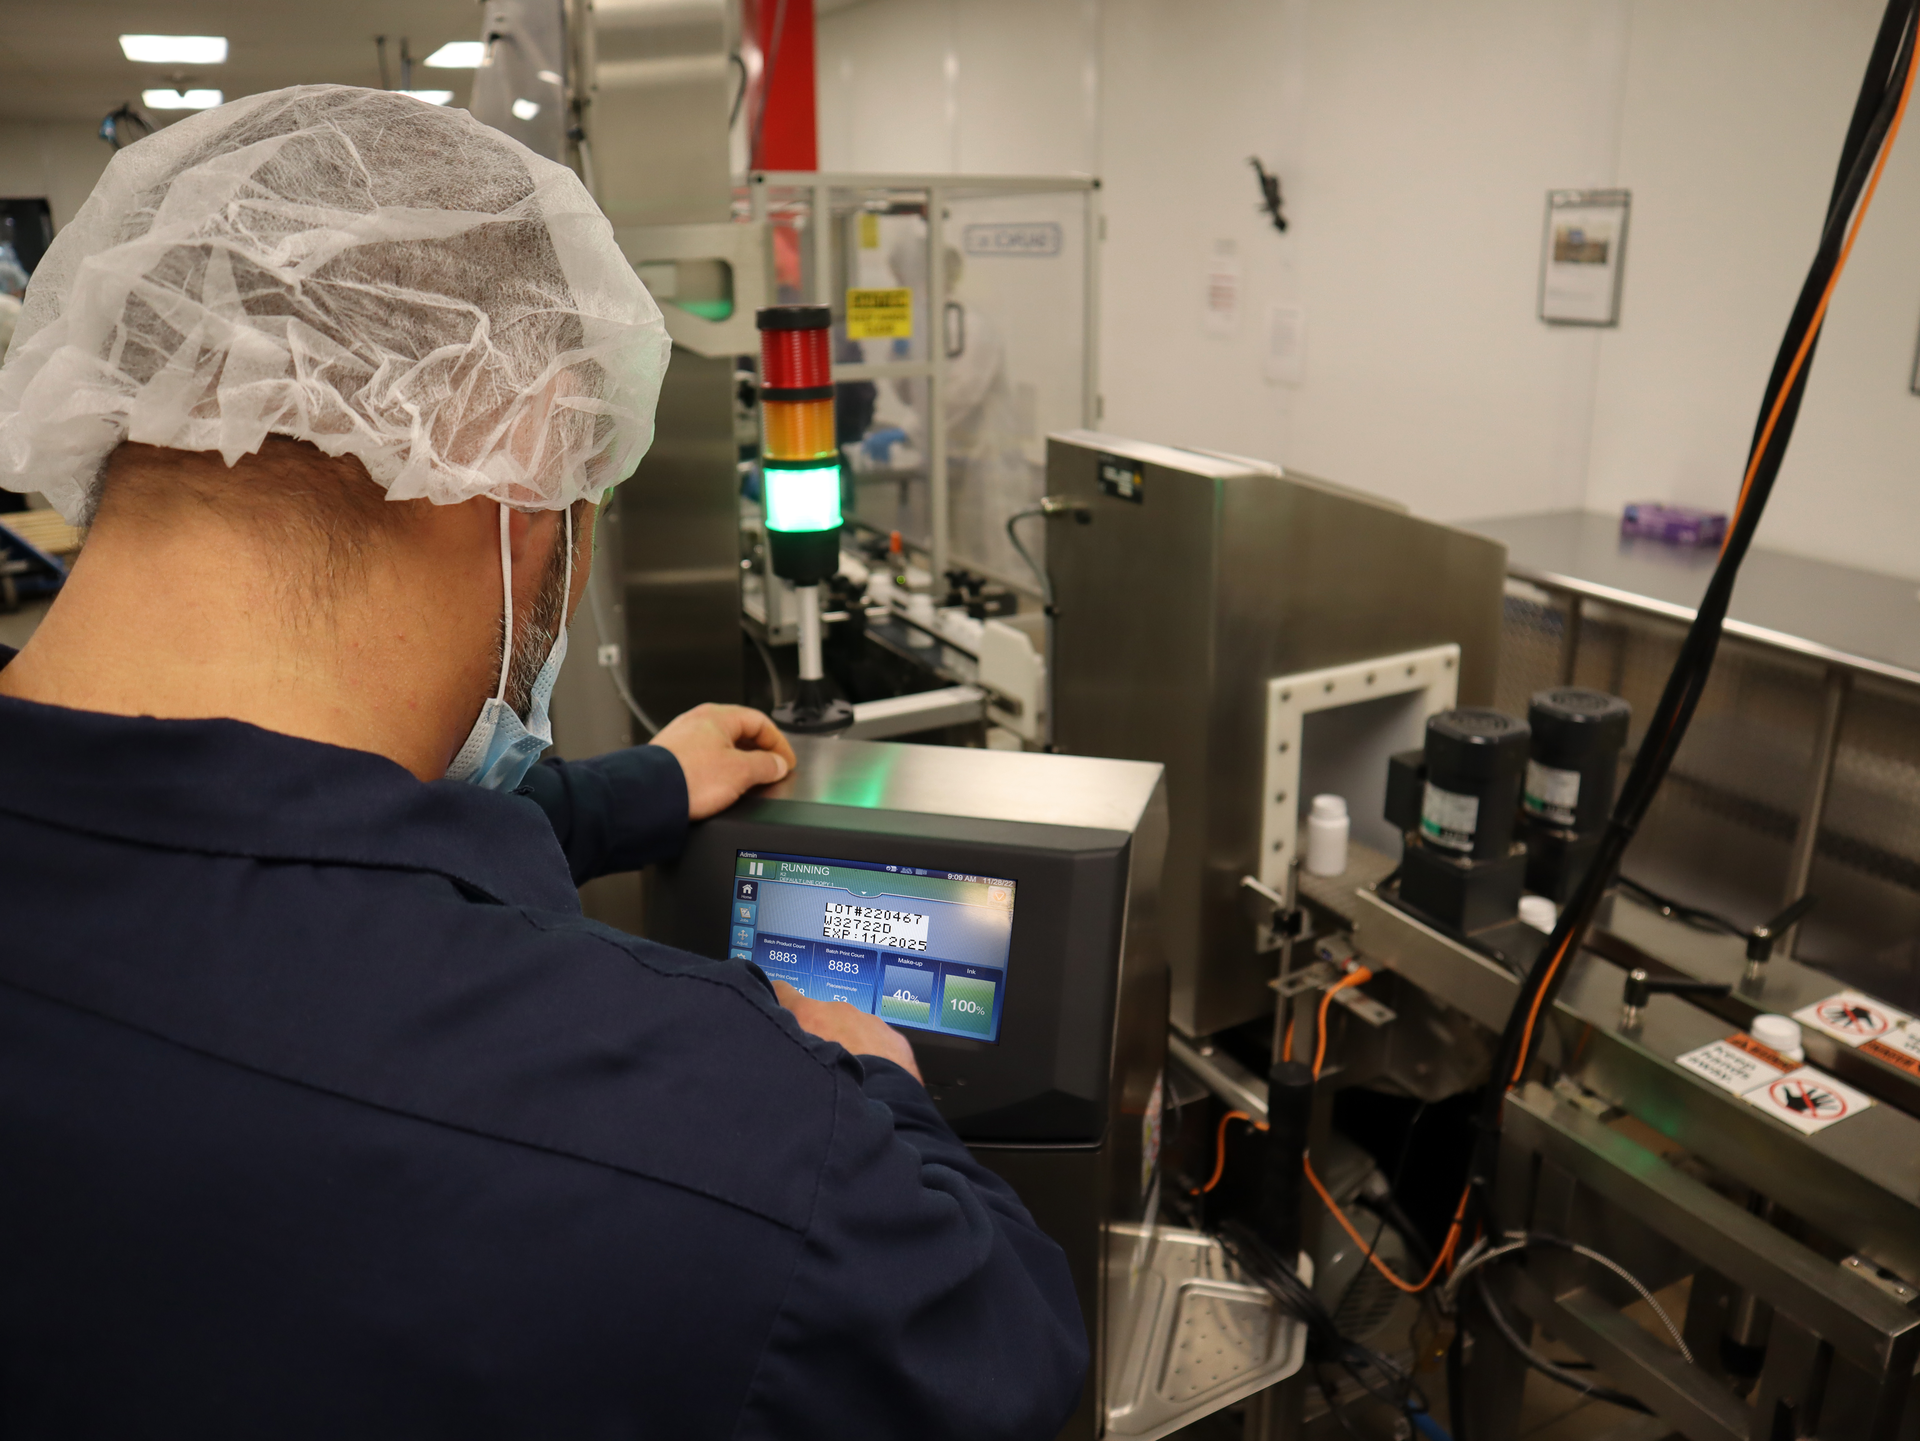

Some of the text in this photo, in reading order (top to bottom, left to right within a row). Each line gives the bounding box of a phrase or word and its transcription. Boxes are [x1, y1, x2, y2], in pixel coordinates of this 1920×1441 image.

[780, 862, 830, 876] RUNNING
[947, 873, 963, 881] 9:09
[964, 875, 977, 883] AM
[825, 902, 922, 924] LOT#220467
[823, 915, 892, 934] W32722D
[768, 950, 798, 964] 8883
[839, 949, 850, 957] Print
[850, 951, 865, 959] Count
[828, 960, 859, 975] 8883
[898, 957, 923, 967] Make-up
[785, 974, 799, 982] Count
[893, 989, 920, 1005] 40%
[950, 998, 985, 1016] 100%
